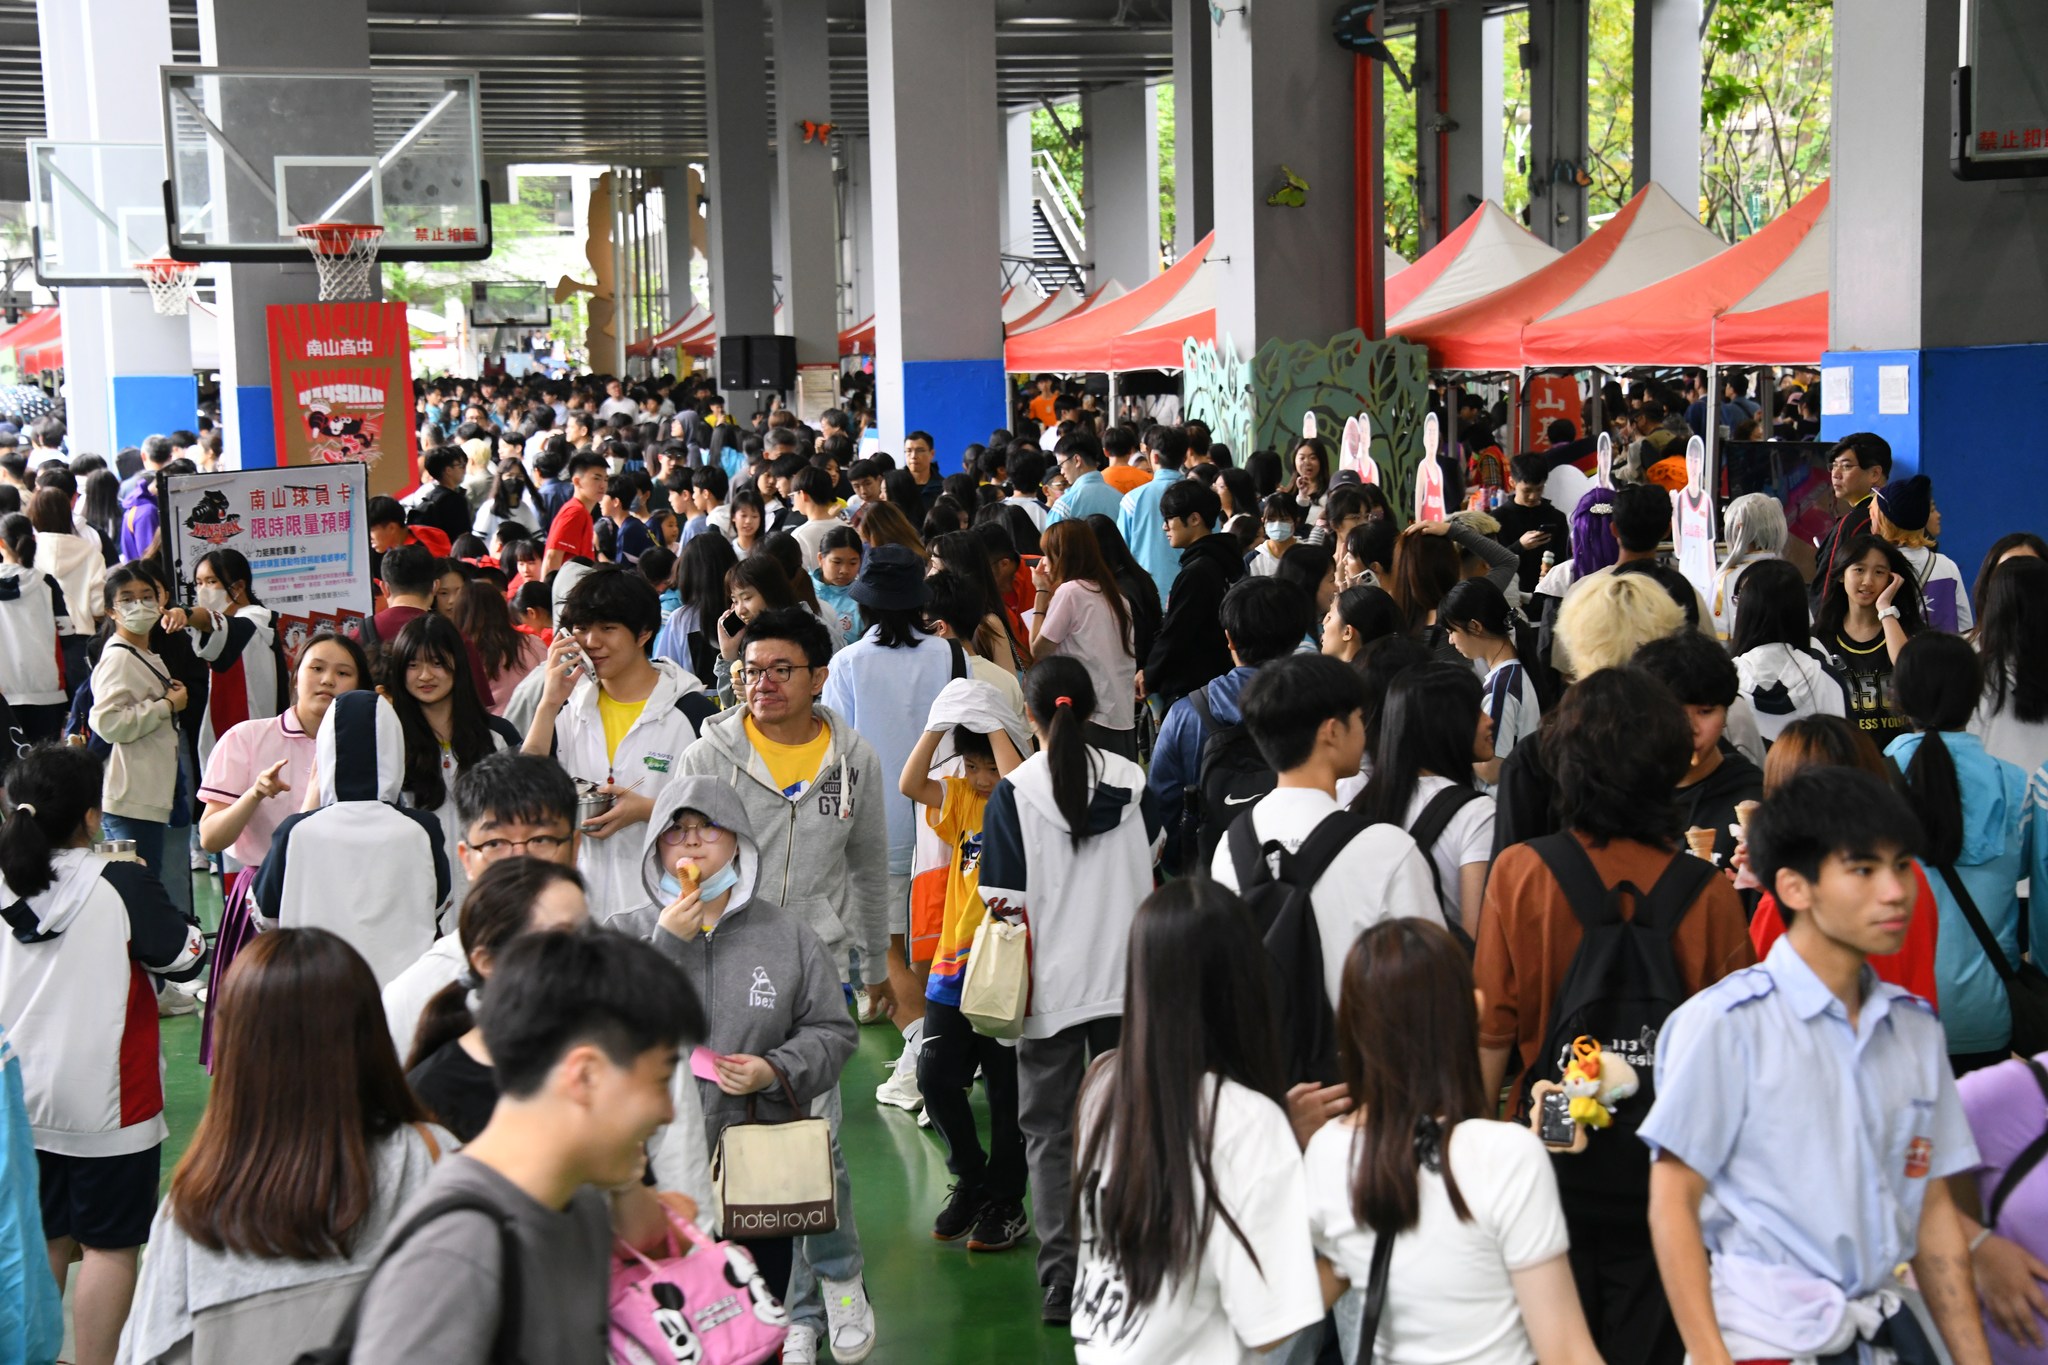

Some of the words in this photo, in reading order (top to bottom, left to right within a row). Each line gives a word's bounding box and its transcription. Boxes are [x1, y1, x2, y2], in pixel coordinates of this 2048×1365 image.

[1979, 128, 2048, 150] 禁止扣
[306, 338, 373, 357] 南山高中
[299, 384, 384, 405] NANSHAN
[250, 483, 351, 511] 南山球員卡
[749, 992, 775, 1009] Ibex
[1612, 1039, 1638, 1052] 113
[733, 1210, 780, 1229] hotel
[783, 1206, 827, 1229] royal
